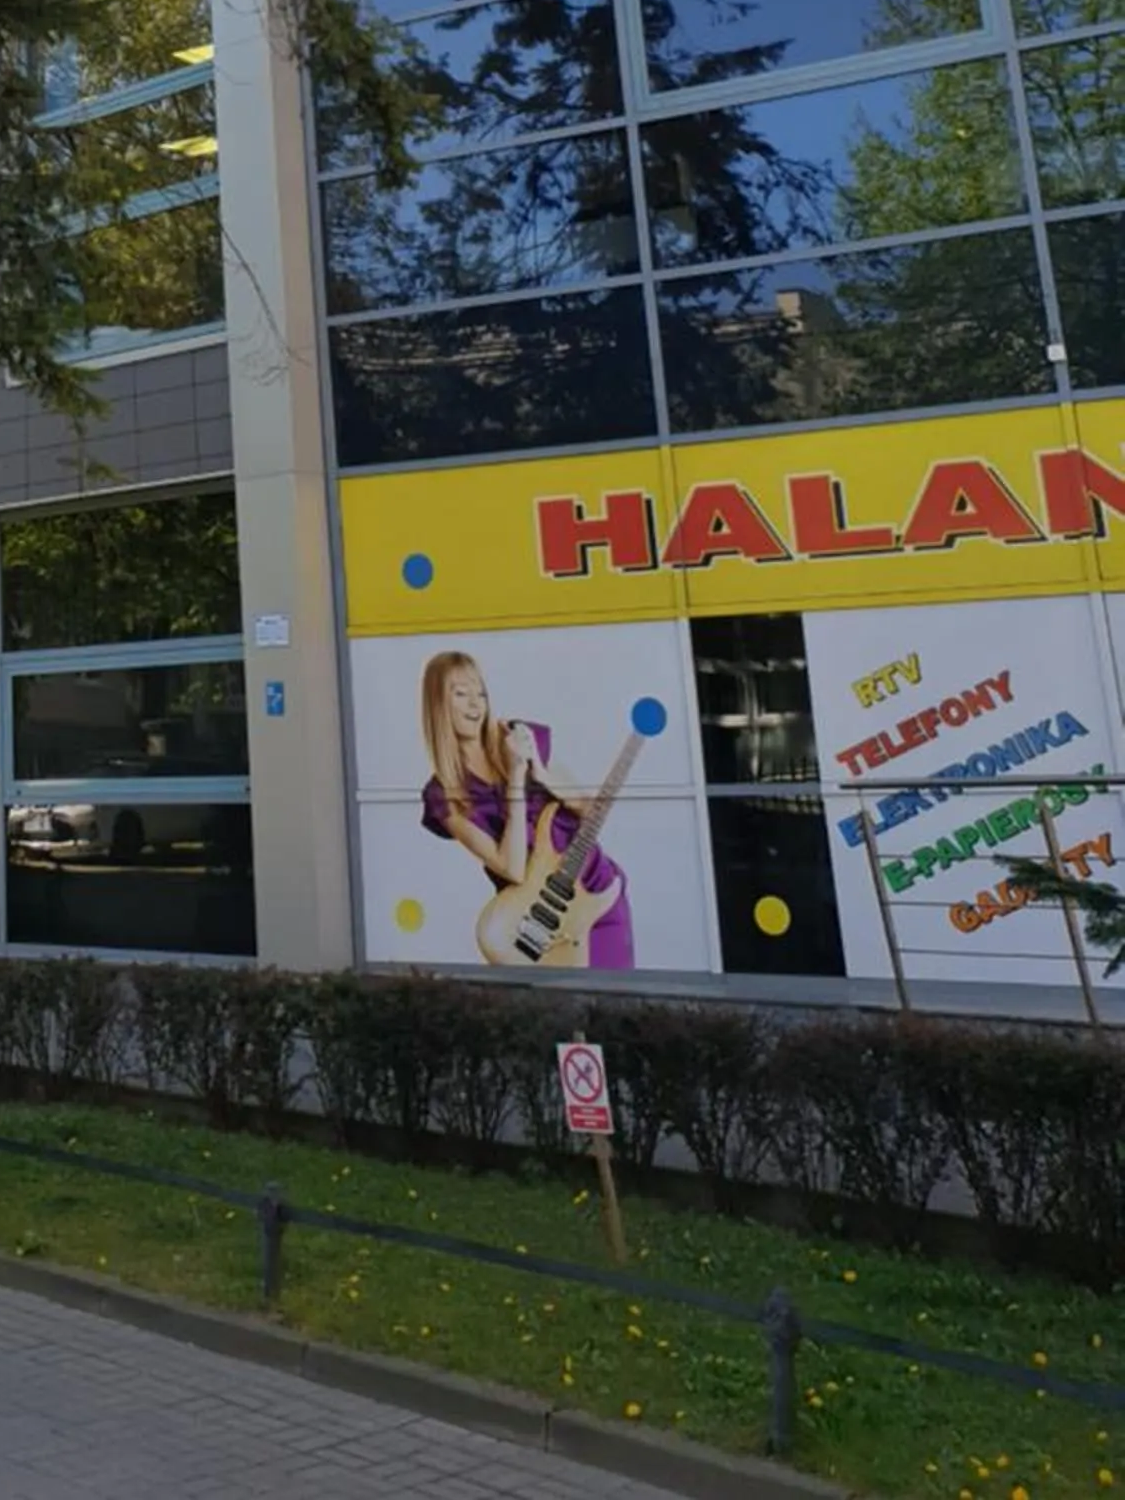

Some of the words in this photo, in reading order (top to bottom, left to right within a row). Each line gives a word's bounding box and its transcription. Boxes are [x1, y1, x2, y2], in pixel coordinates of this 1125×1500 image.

[836, 670, 1015, 777] TELEFONY
[851, 653, 922, 708] RTV
[949, 832, 1116, 934] GADTY
